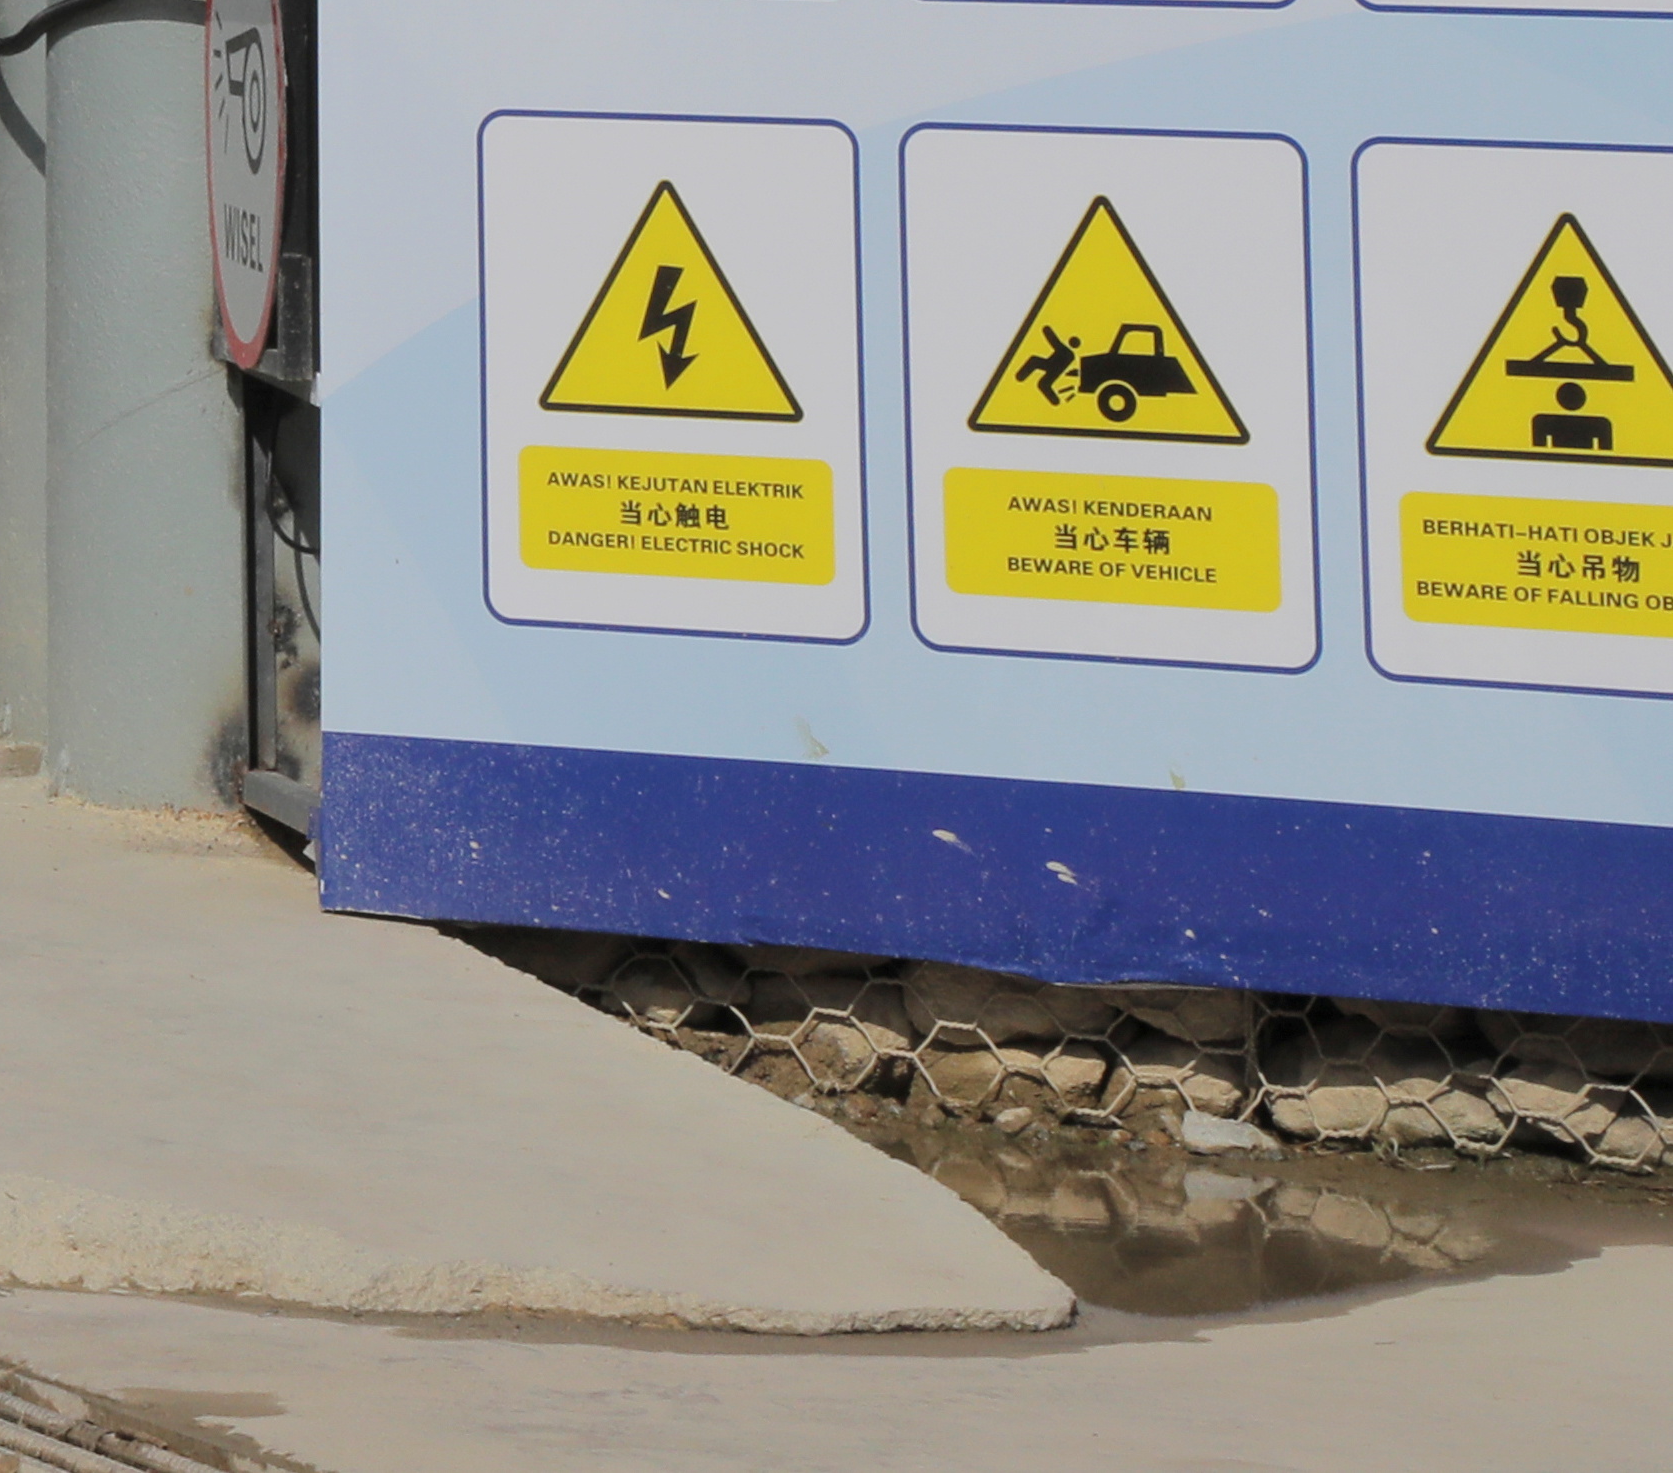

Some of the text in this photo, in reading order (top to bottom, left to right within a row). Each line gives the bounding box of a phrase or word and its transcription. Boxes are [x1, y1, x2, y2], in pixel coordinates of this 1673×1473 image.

[223, 201, 264, 274] WISEL
[547, 471, 804, 499] AWAS! KEJUTAN ELEKTRIK
[618, 500, 730, 531] 当心触电
[1007, 496, 1213, 522] AWAS! KENDERAAN
[547, 530, 805, 560] DANGER! ELECTRIC SHOCK
[1053, 524, 1172, 556] 当心车辆
[1422, 518, 1655, 547] BERHATI-HATI OBJEK
[1007, 555, 1218, 585] BEWARE OF VEHICLE
[1517, 550, 1640, 583] 当心吊物
[1417, 581, 1639, 609] BEWARE OF FALLING
